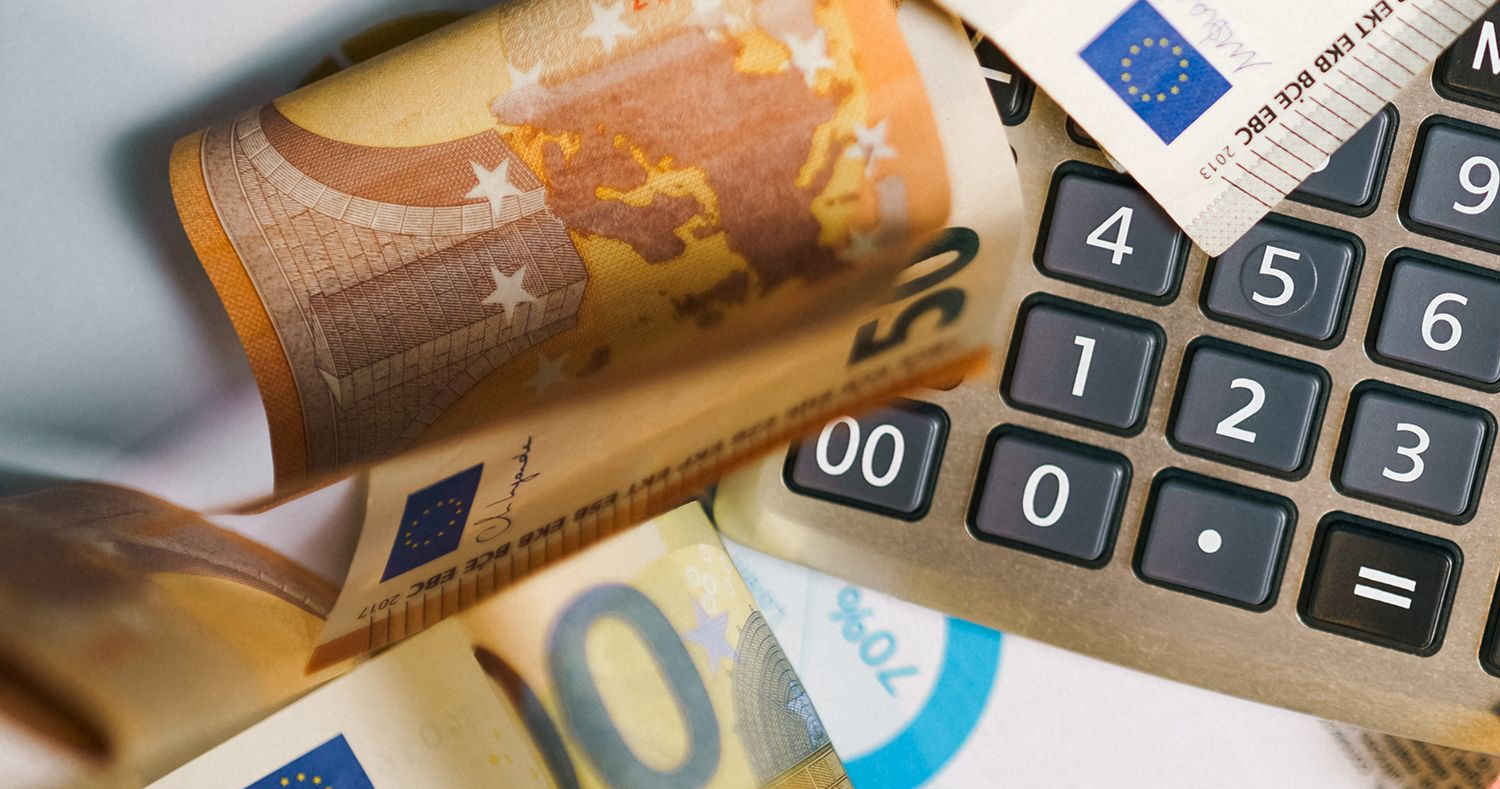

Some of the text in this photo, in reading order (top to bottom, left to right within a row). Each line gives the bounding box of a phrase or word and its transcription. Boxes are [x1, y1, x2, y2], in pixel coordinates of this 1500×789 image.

[1355, 0, 1394, 39] EKT
[1314, 33, 1356, 74] EKB
[1234, 105, 1278, 146] EBC
[1199, 145, 1236, 181] 2013
[1452, 155, 1500, 215] 9
[1086, 206, 1134, 265] 4
[1252, 245, 1300, 306] 5
[1421, 292, 1468, 352] 6
[1072, 335, 1096, 397] 1
[1215, 377, 1266, 443] 2
[816, 416, 905, 487] 00
[1382, 422, 1431, 483] 3
[1022, 464, 1070, 527] 0
[519, 516, 567, 547] EKB
[357, 593, 401, 620] 2017
[406, 566, 458, 599] EBC
[826, 585, 919, 698] 70%
